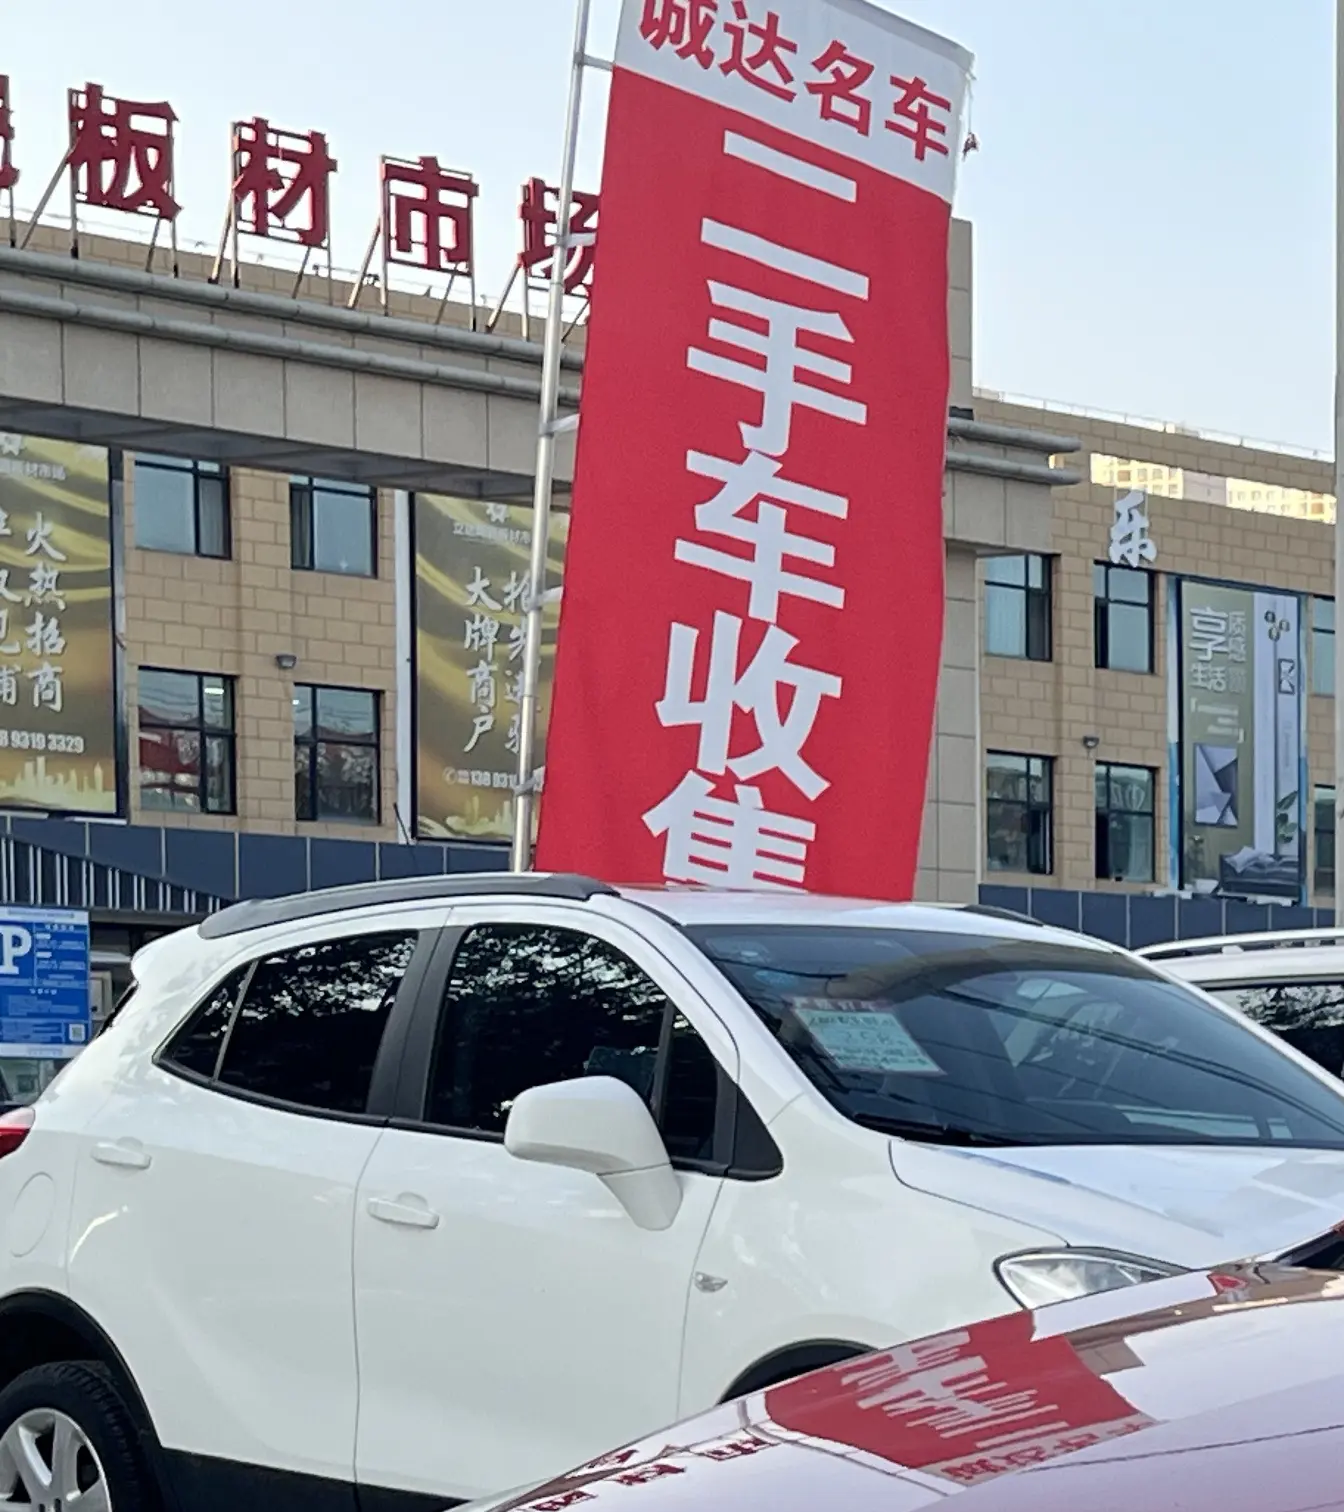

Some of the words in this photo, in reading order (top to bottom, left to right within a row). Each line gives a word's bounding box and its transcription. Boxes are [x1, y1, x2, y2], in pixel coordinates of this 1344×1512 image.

[639, 0, 952, 162] 诚达名车
[0, 75, 600, 295] 板材市场
[25, 511, 67, 712] 火热招商
[463, 565, 503, 752] 大牌商户
[0, 924, 32, 975] P
